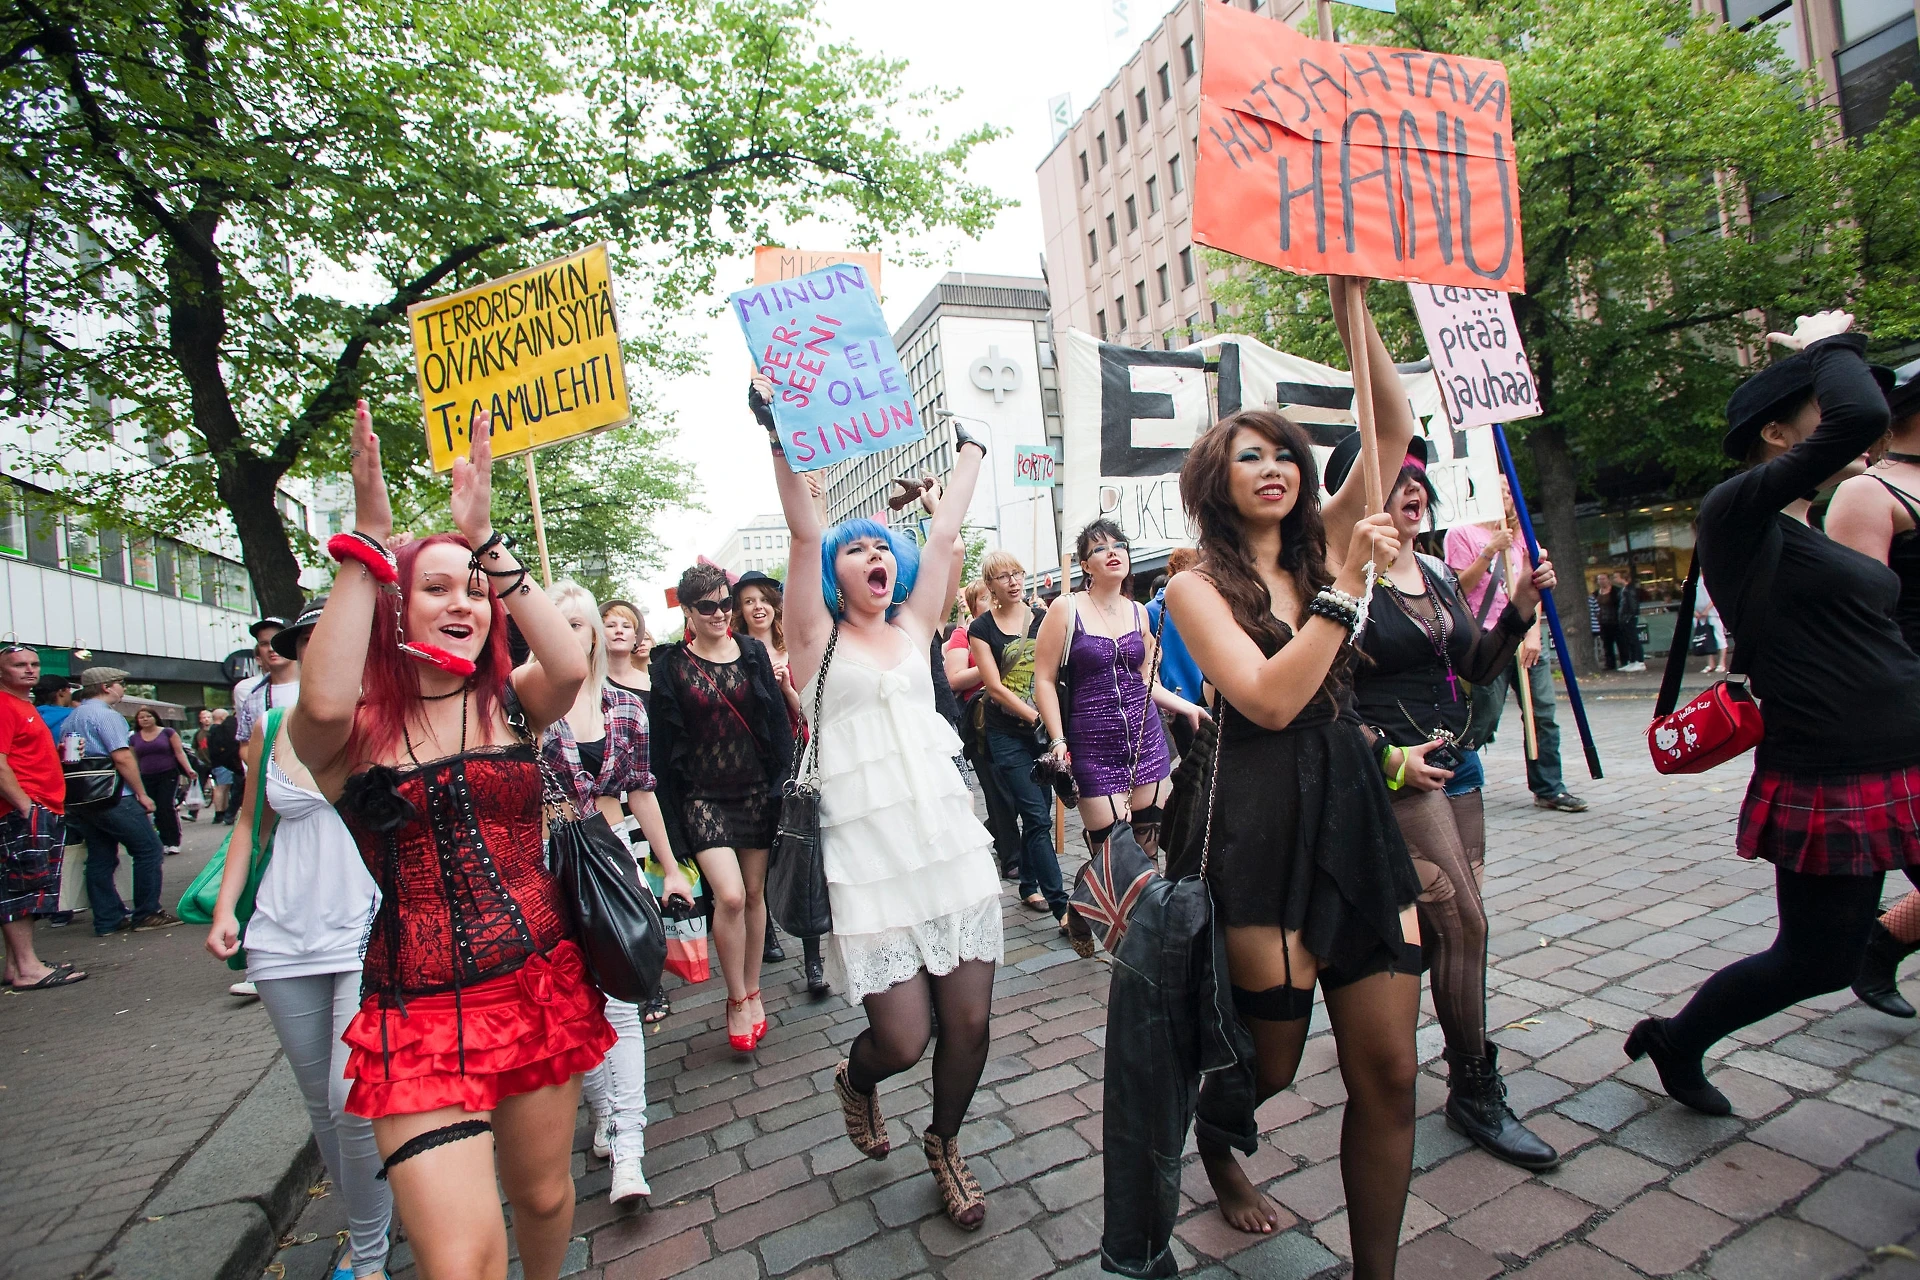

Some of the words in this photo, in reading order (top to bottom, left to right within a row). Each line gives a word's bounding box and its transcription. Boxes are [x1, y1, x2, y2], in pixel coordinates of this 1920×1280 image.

[1209, 51, 1507, 169] HUTSAHTAVA
[1278, 107, 1514, 281] HANU
[737, 266, 866, 323] MINUN
[780, 255, 845, 281] MIK
[417, 257, 589, 351] TERRORISMIKIN
[423, 341, 464, 394] ON
[557, 280, 617, 347] SYYTÄ
[782, 314, 843, 409] SEENI
[843, 339, 882, 370] EI
[1438, 308, 1507, 368] pitää
[828, 366, 900, 406] OLE
[791, 400, 914, 462] SINUN
[1017, 452, 1054, 481] PORTTO
[1426, 465, 1480, 523] STA
[1678, 706, 1696, 722] Hello
